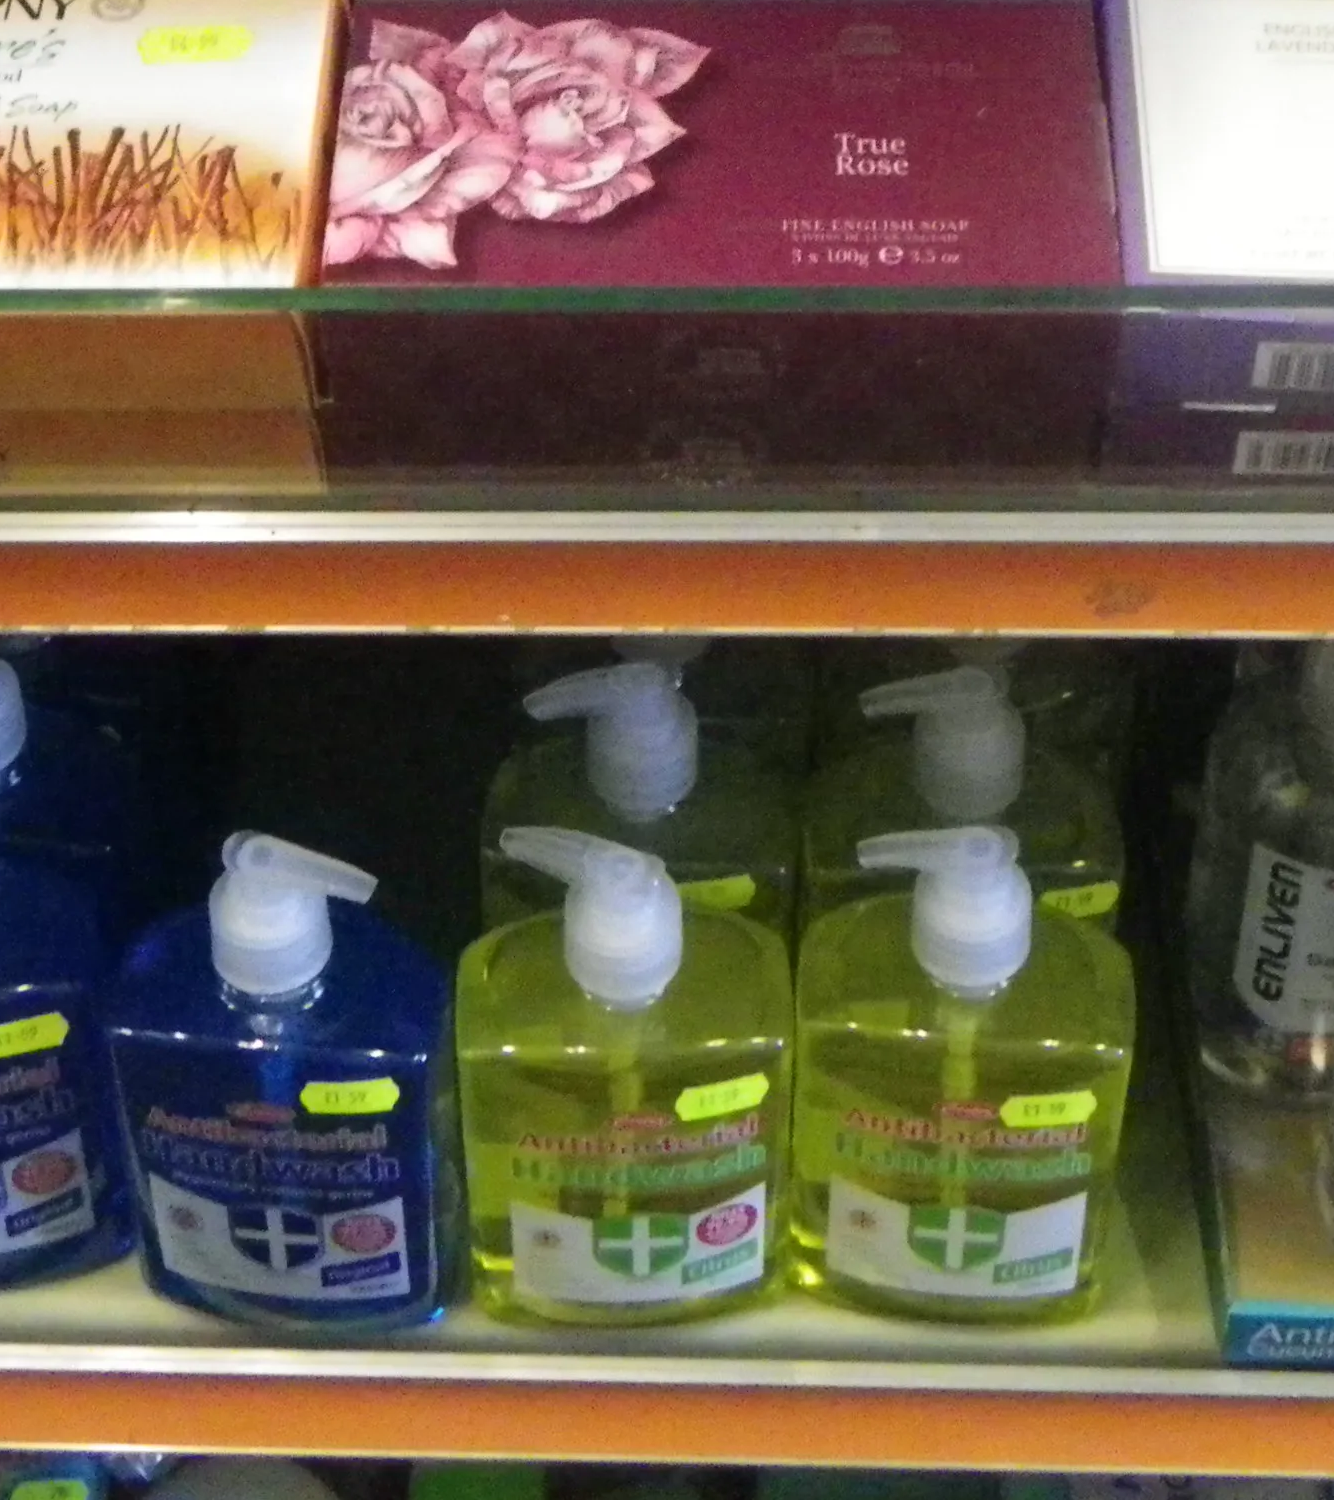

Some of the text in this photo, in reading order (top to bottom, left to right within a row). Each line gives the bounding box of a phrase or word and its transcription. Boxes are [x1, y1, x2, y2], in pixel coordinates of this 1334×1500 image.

[6, 93, 79, 122] Soap
[833, 132, 907, 156] True
[835, 154, 910, 177] Rose
[781, 218, 970, 232] FINE ENGLISH SOAP
[826, 248, 870, 269] 100g
